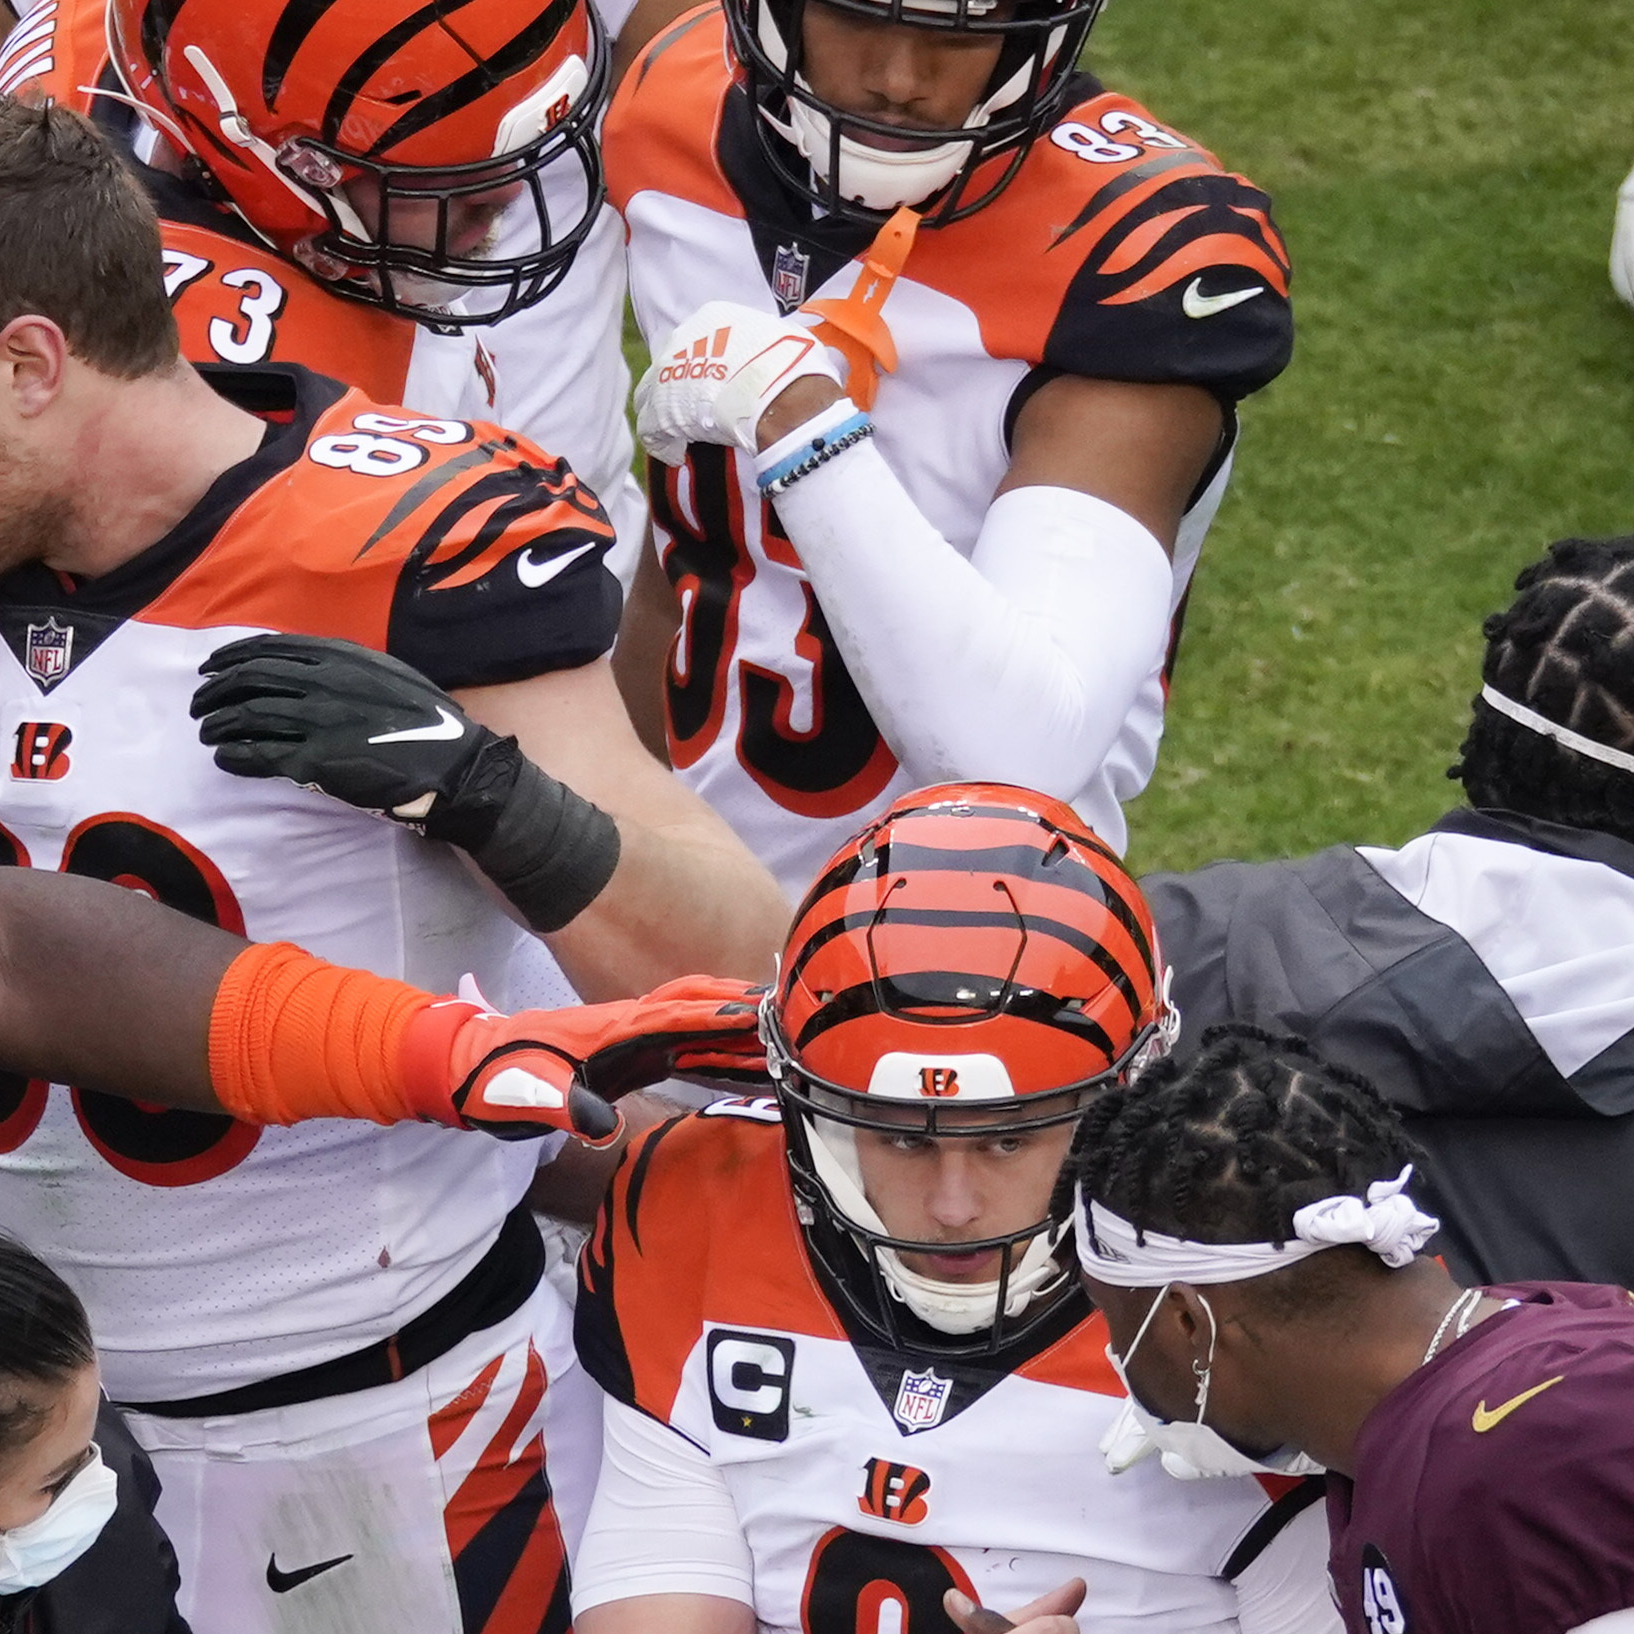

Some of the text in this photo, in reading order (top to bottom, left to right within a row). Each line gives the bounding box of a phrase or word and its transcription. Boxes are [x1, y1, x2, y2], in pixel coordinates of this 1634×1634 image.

[1049, 110, 1190, 164] 83
[659, 357, 728, 384] adidas
[32, 648, 62, 674] NFL
[707, 1338, 787, 1412] C
[902, 1390, 942, 1423] NFL
